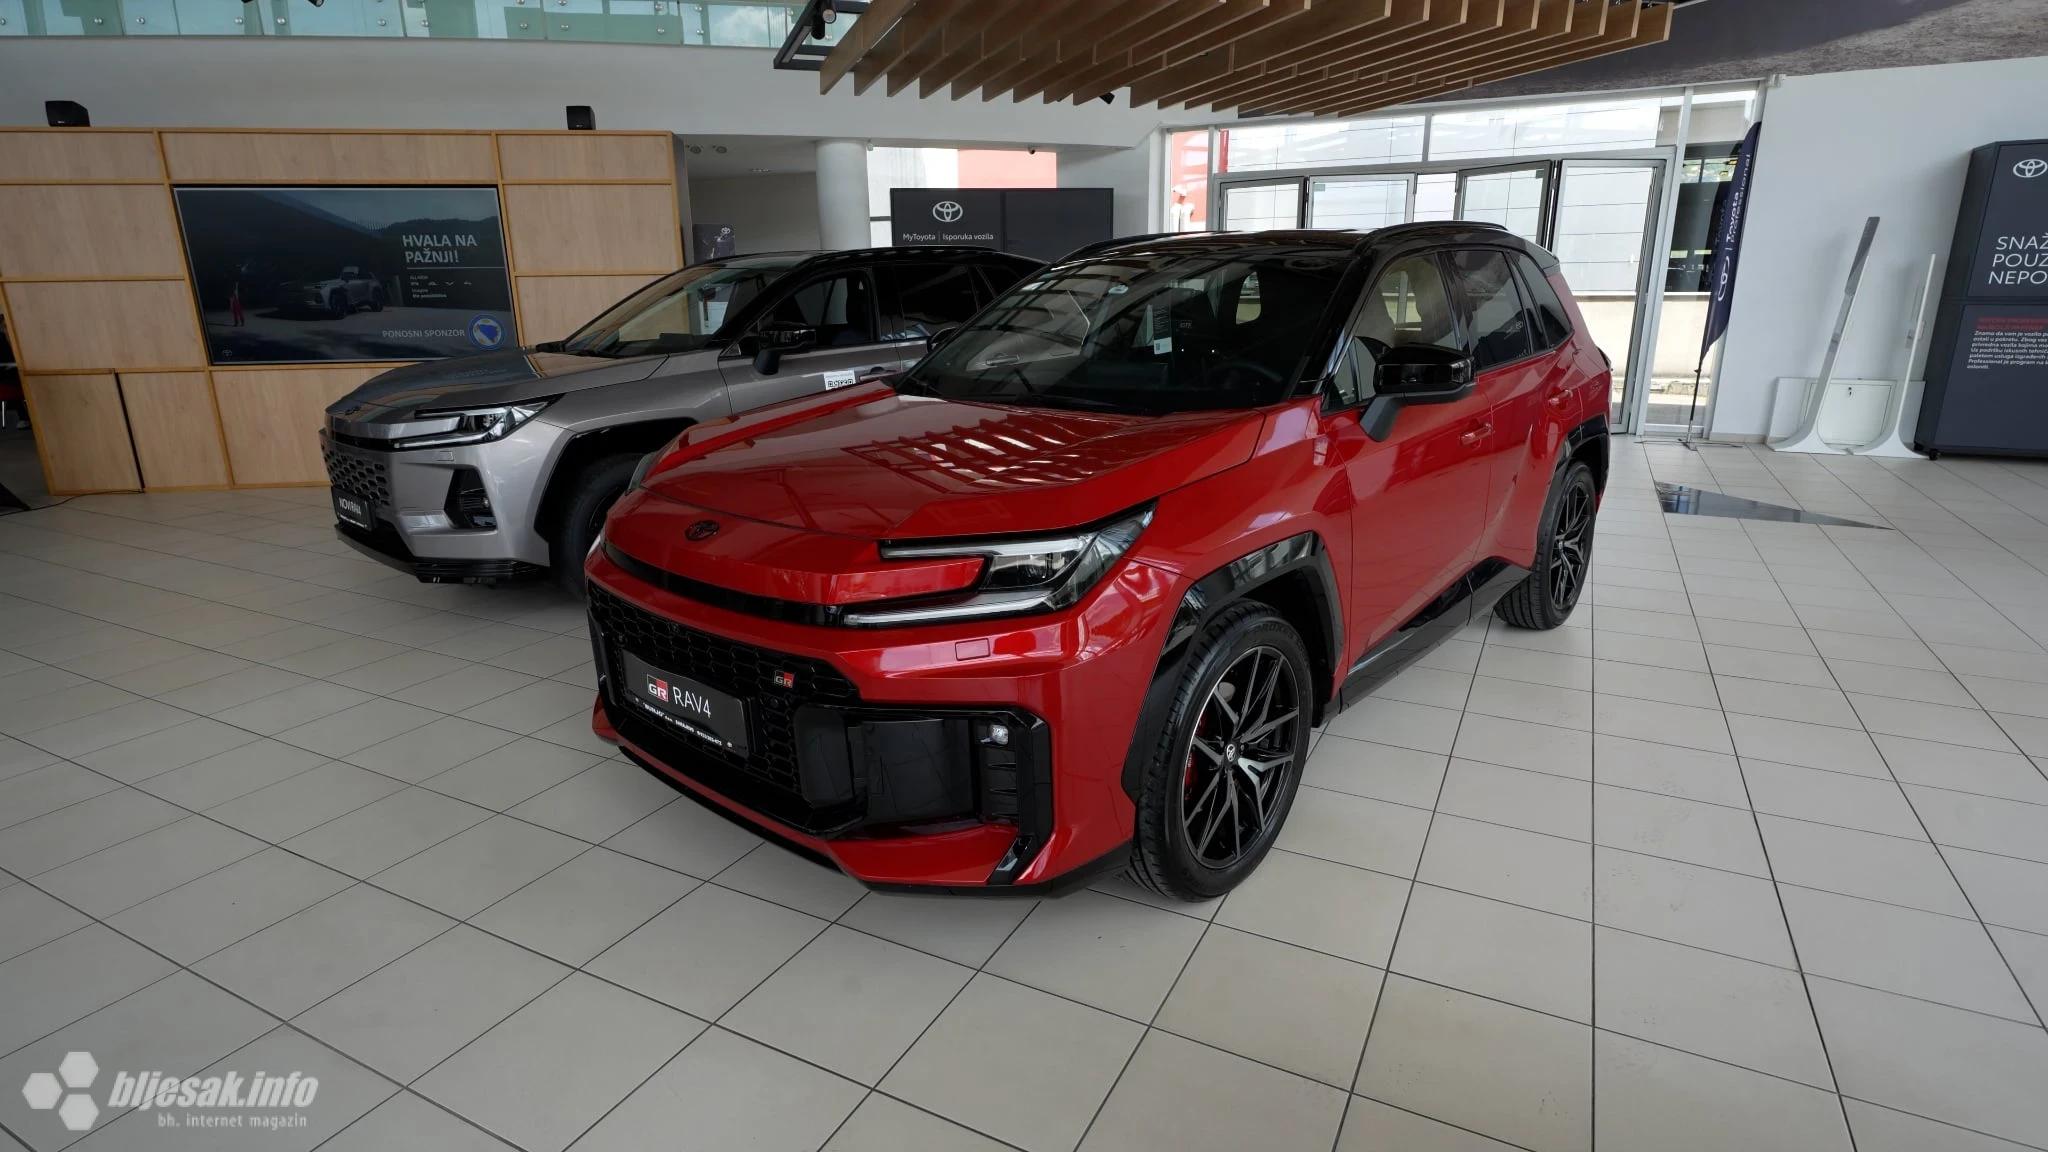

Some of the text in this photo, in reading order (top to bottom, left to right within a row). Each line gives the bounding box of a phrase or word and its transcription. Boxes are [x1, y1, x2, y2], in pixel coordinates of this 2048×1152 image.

[1725, 192, 1739, 243] Toyota
[402, 234, 478, 247] HVALA NA
[902, 233, 936, 242] MyToyota
[942, 233, 973, 242] Isporuka
[405, 247, 460, 263] PAŽNJI!
[382, 329, 465, 338] PONOSNI SPONZOR
[774, 675, 793, 688] GR
[648, 682, 667, 700] GR
[672, 685, 712, 719] RAV4
